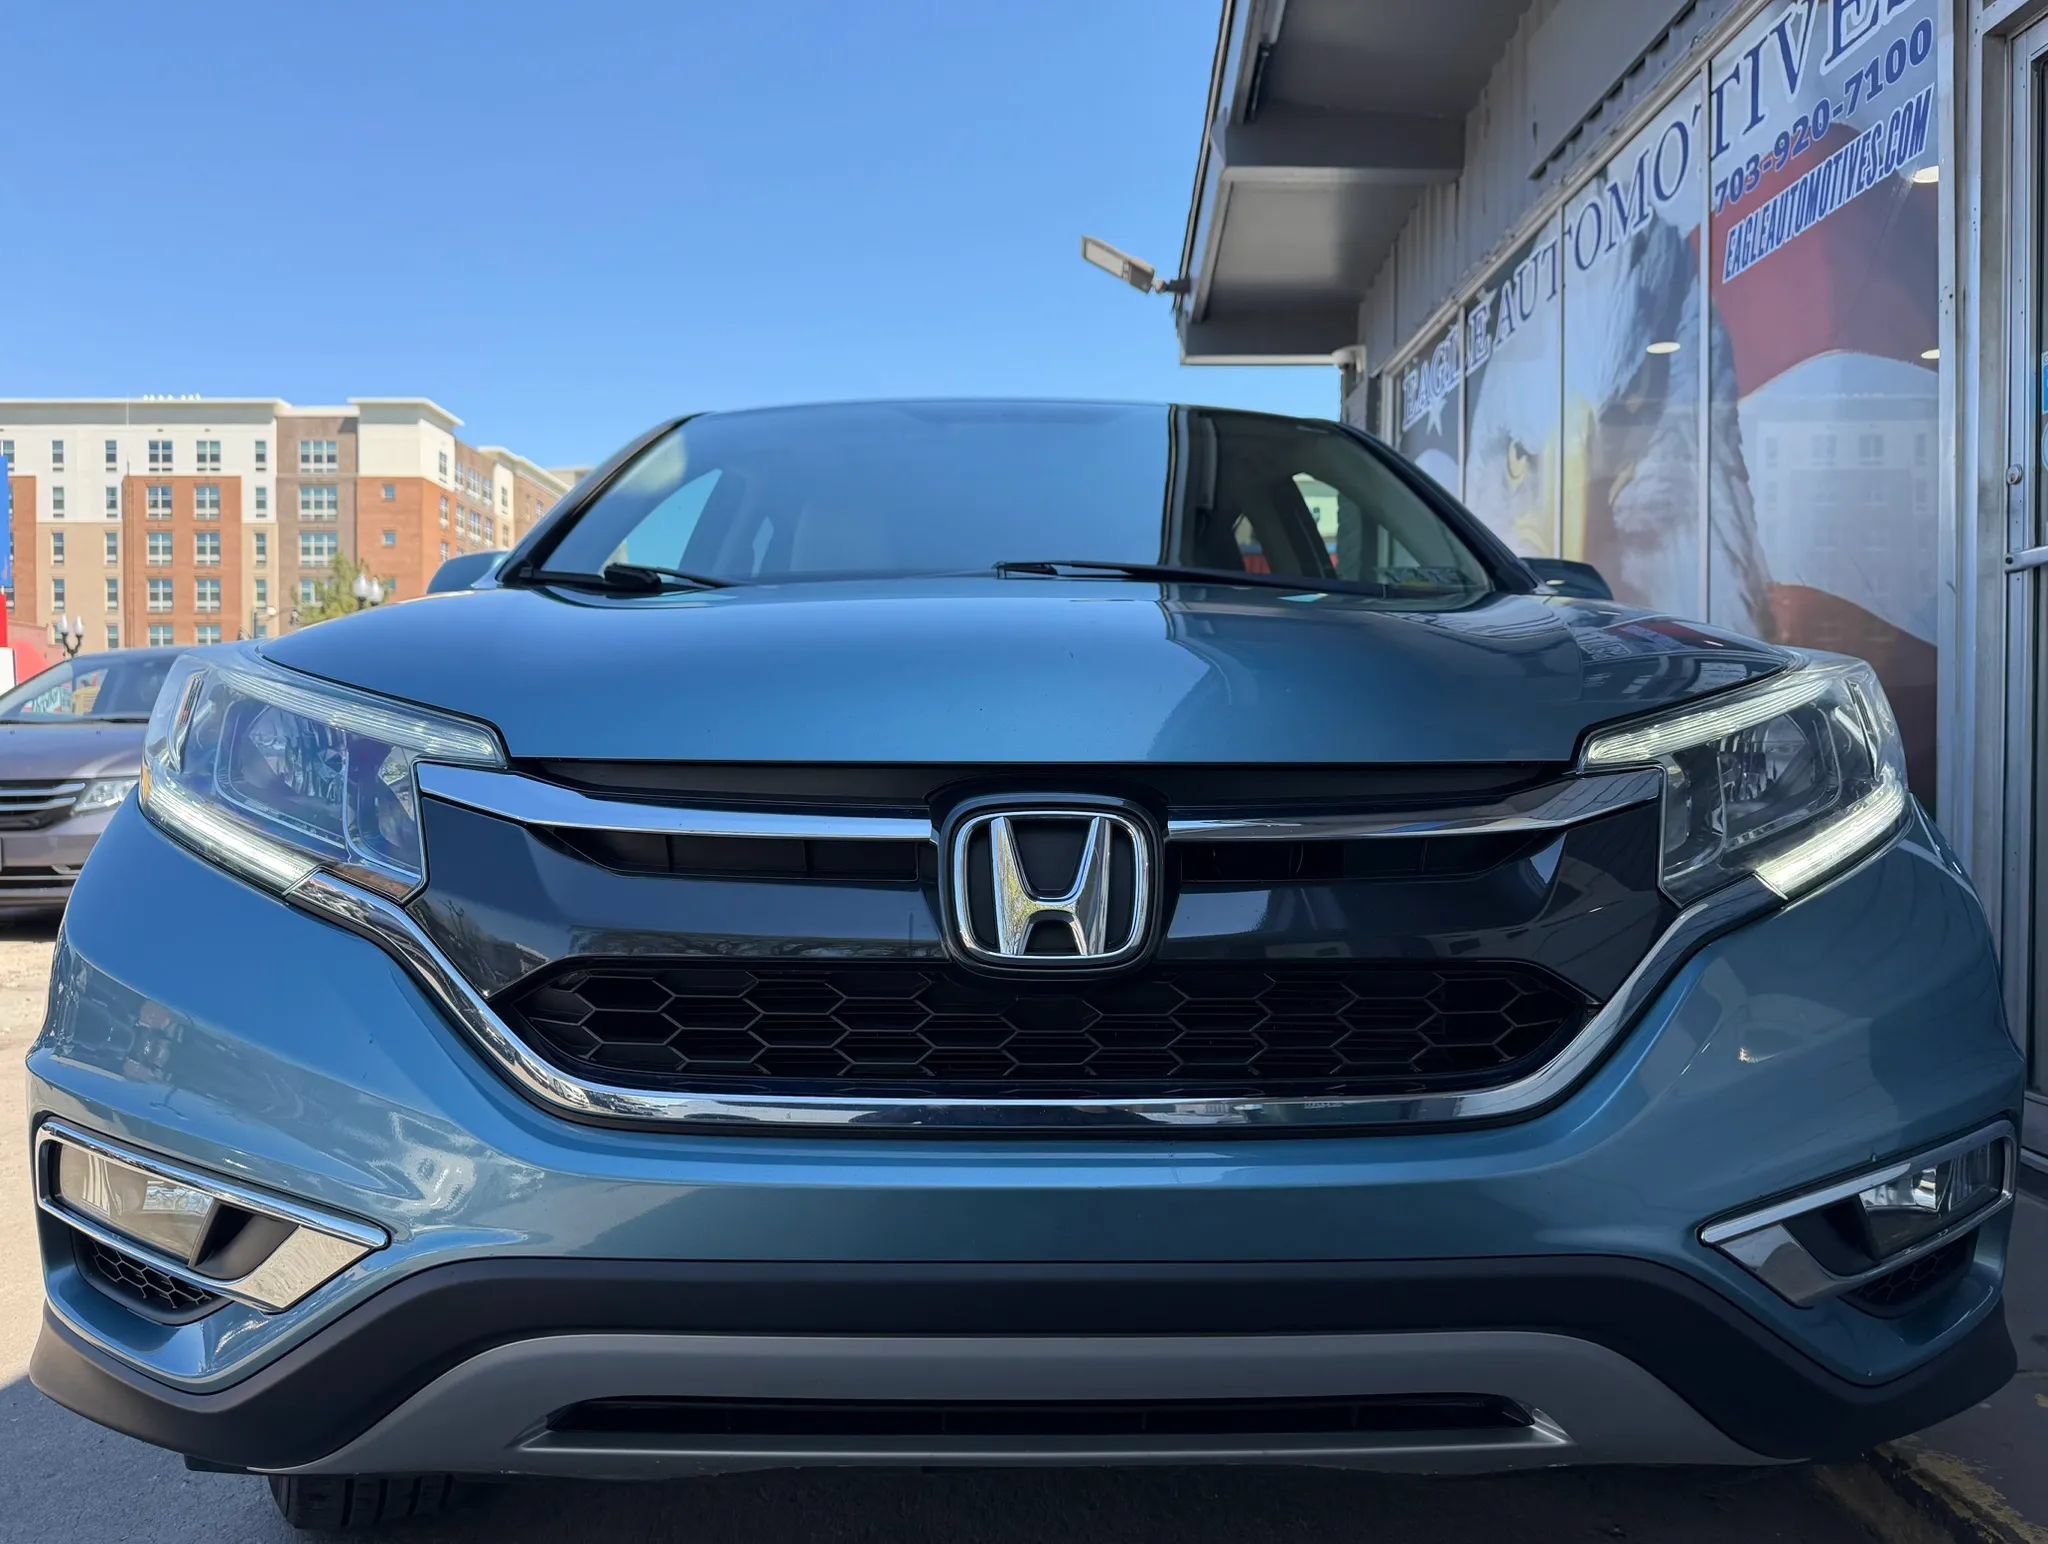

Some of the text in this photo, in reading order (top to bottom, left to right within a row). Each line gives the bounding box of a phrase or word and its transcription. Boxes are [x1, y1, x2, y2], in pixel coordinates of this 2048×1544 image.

[1402, 0, 1915, 431] EAGLE AUTOMOTIVE
[1714, 17, 1932, 215] 703-920-7100
[1723, 84, 1934, 283] EAGLEAUTOMOTIVES.COM
